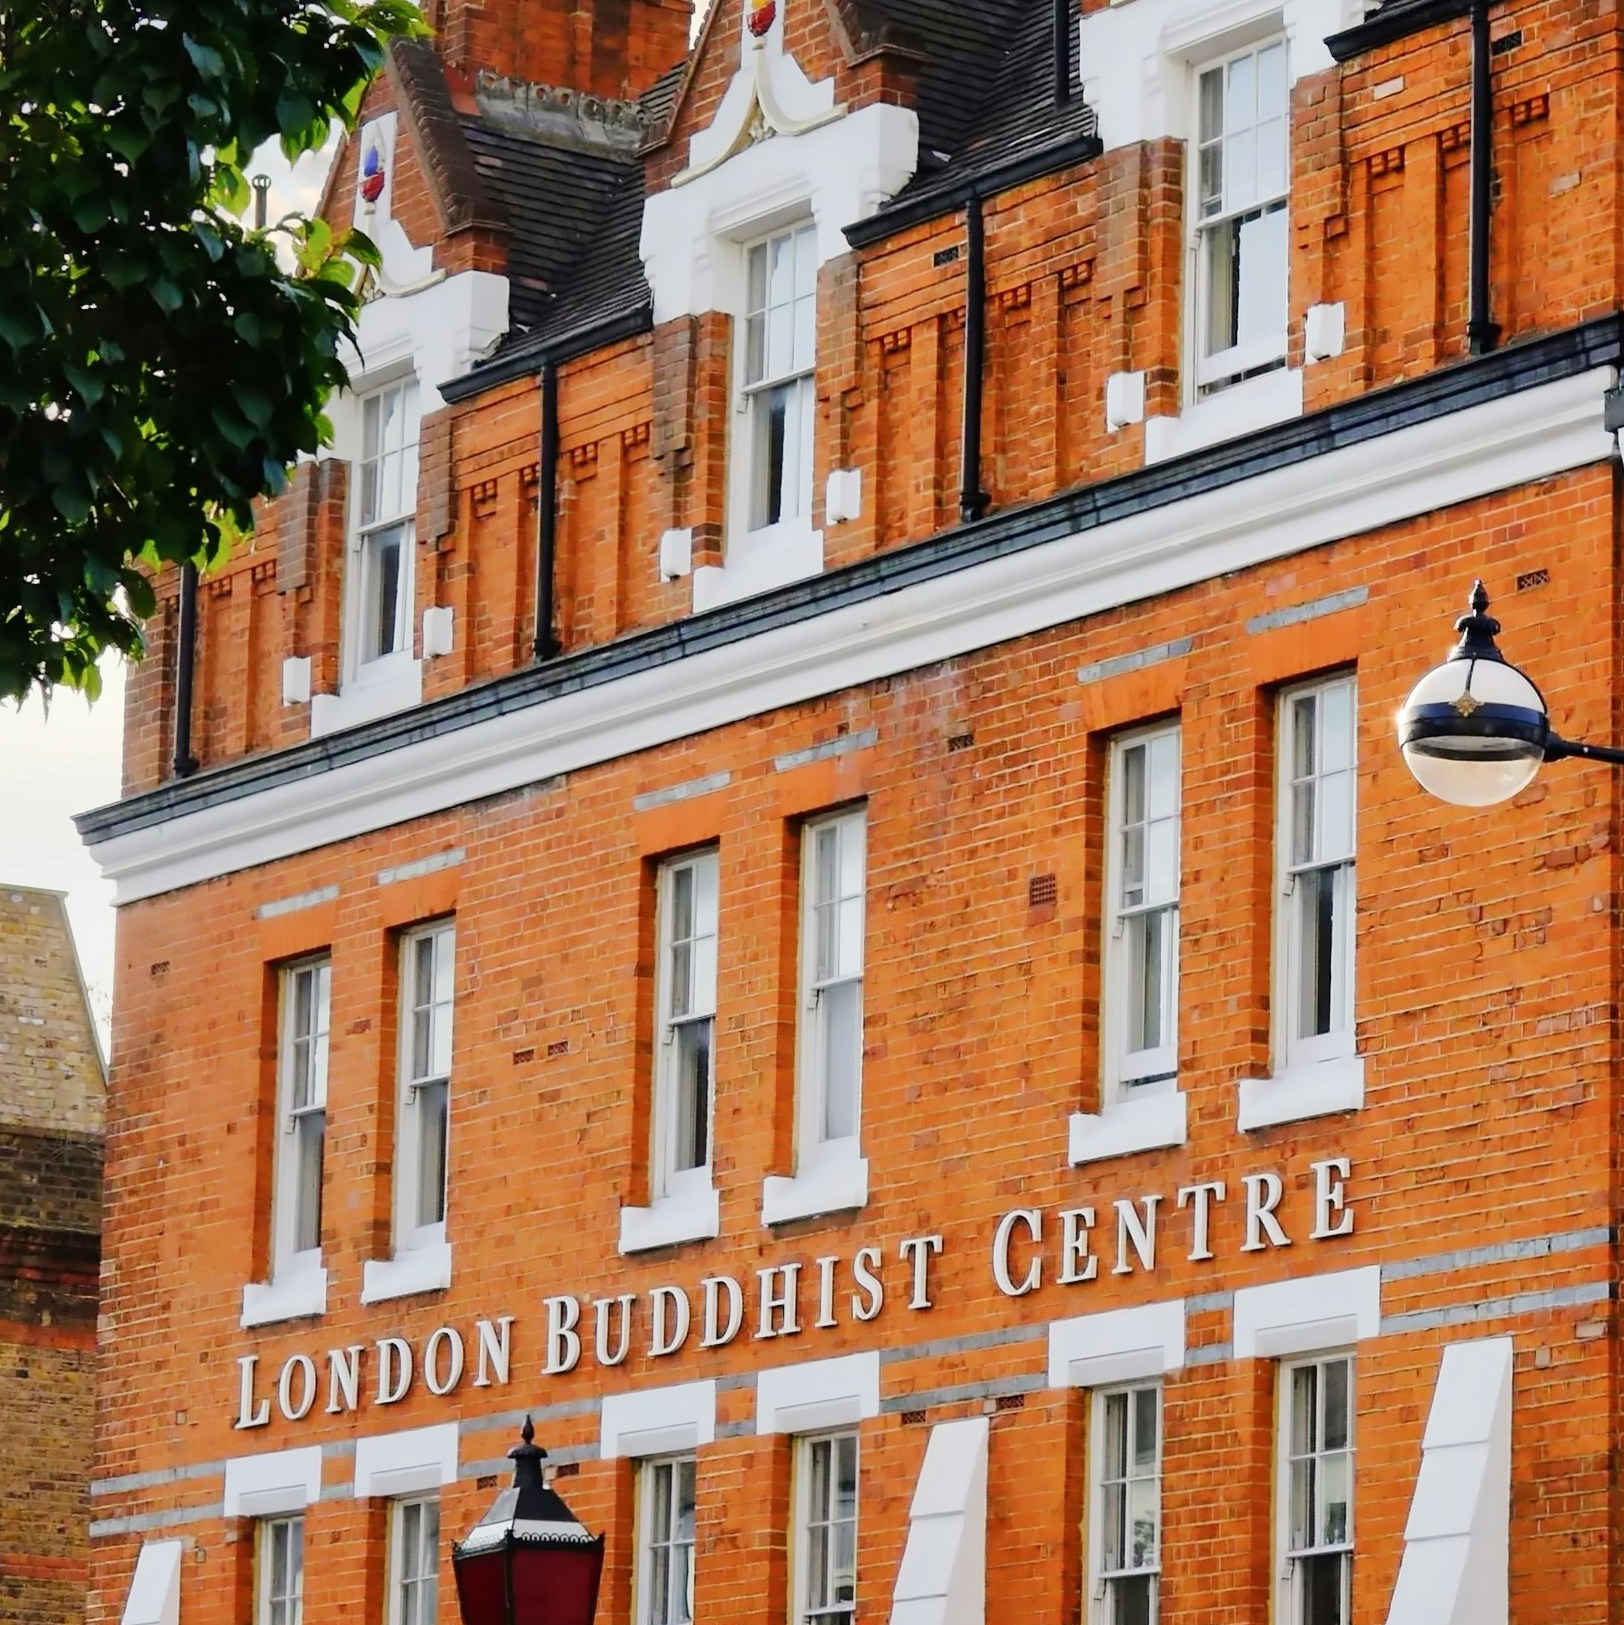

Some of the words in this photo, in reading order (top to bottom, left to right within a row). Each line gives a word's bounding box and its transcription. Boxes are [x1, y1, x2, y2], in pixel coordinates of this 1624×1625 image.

[234, 1315, 516, 1430] LONDON
[540, 1234, 944, 1375] BUDDHIST
[991, 1156, 1355, 1297] CENTRE
